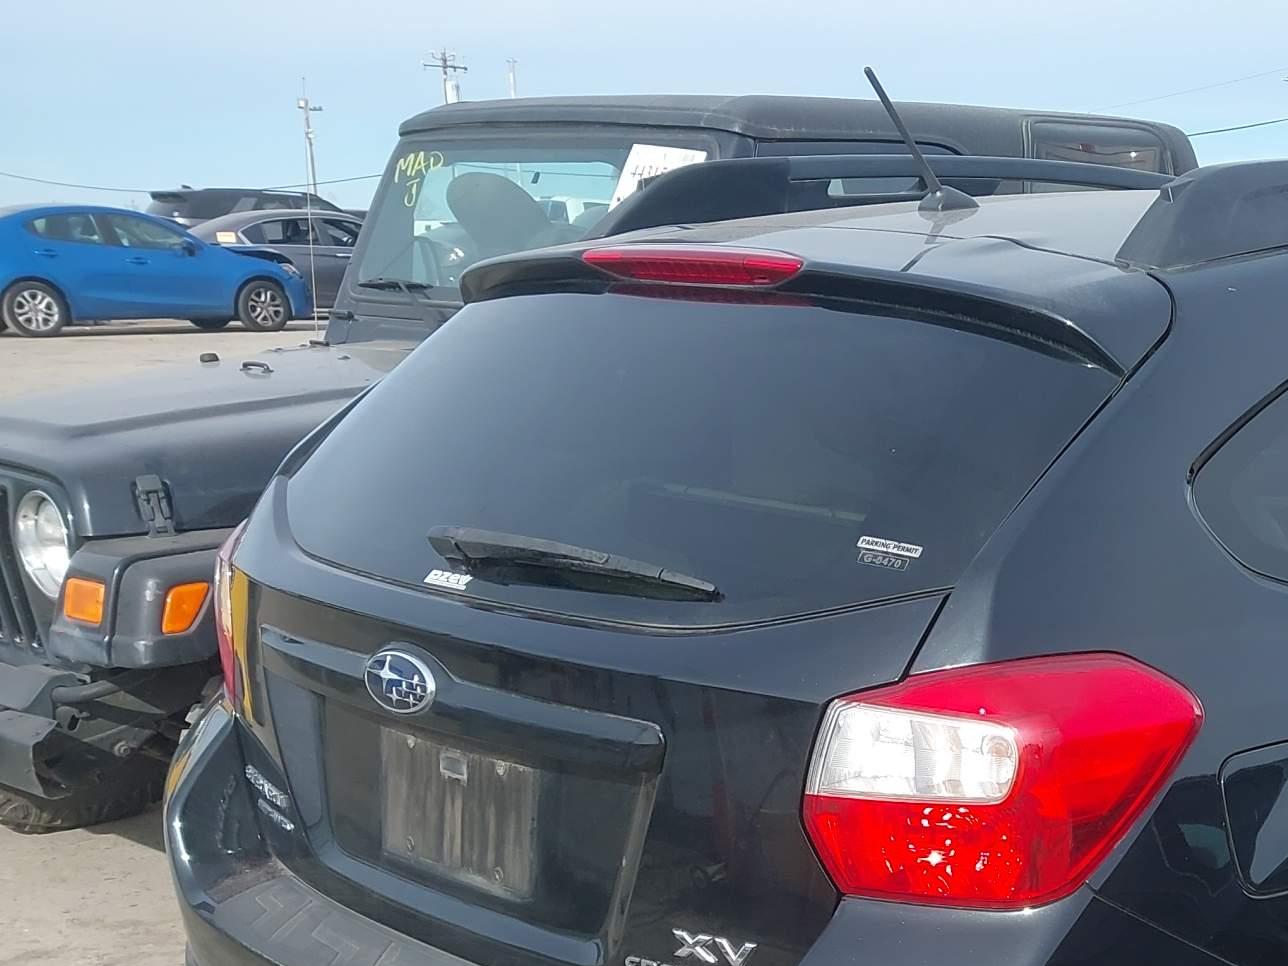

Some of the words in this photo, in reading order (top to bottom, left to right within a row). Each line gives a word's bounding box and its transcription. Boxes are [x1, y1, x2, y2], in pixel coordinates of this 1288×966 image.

[394, 150, 444, 184] MAD
[860, 537, 891, 550] PARKING
[892, 543, 920, 555] PERMIT
